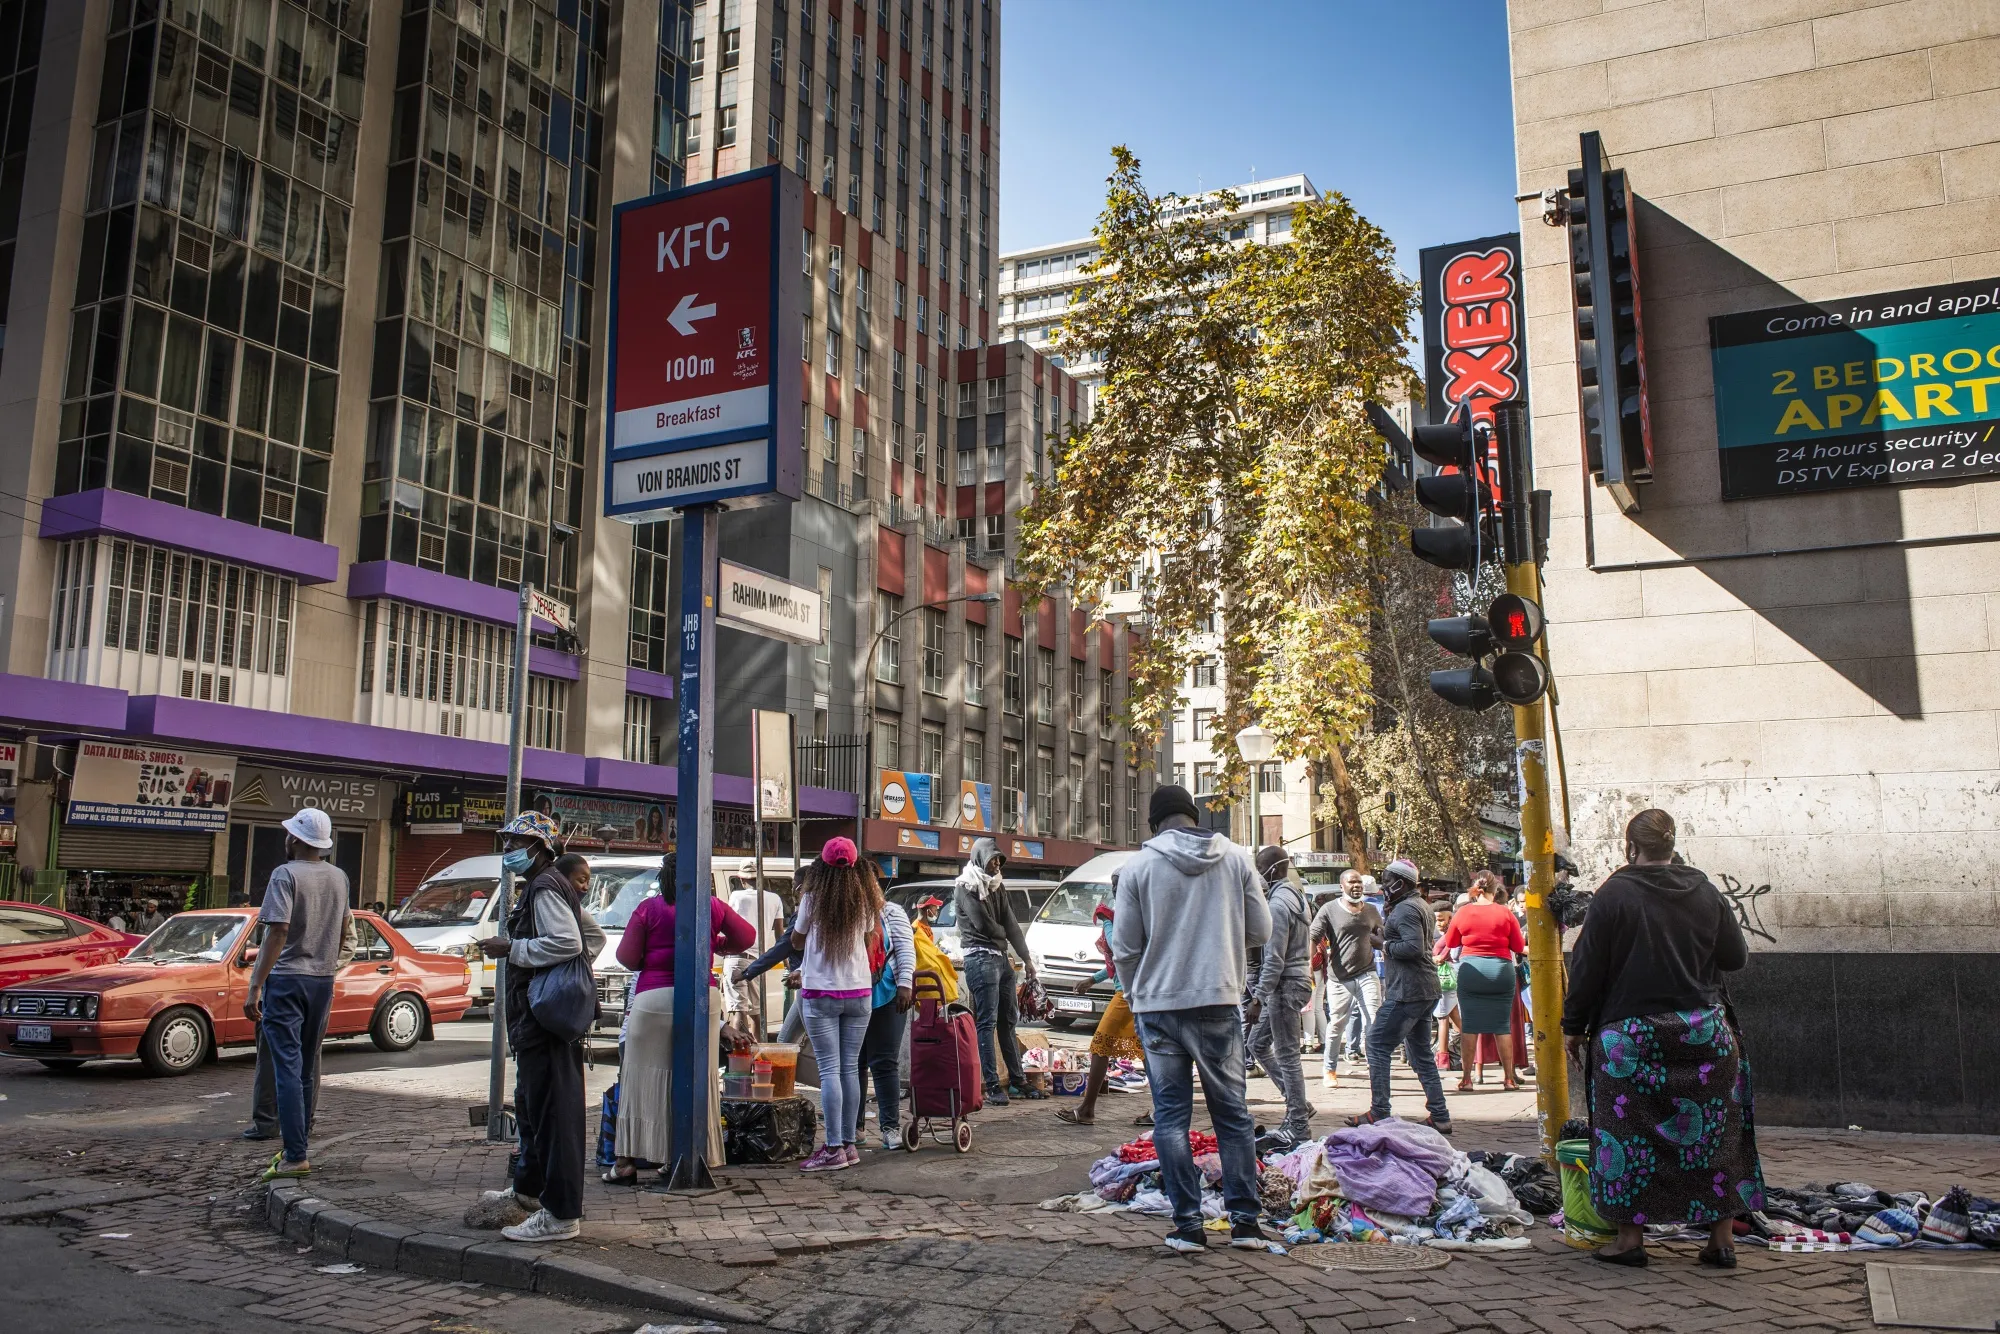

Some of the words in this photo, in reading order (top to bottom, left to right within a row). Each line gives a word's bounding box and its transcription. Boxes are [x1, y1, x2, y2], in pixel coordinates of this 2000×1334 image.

[657, 216, 730, 273] KFC
[1766, 313, 1843, 334] Come
[1850, 307, 1873, 324] in
[1880, 296, 1933, 320] and
[1938, 287, 2000, 315] appl
[736, 348, 758, 360] KFC
[666, 355, 715, 382] 100m
[1771, 370, 1798, 395] 2
[656, 404, 722, 429] Breakfast
[1773, 376, 2000, 435] APART
[1775, 446, 1806, 463] 24
[1812, 440, 1878, 460] hours
[1883, 430, 1978, 452] security
[637, 471, 663, 494] VON
[667, 461, 721, 488] BRANDIS
[725, 458, 741, 480] ST
[1777, 464, 1842, 485] DSTV
[1847, 459, 1934, 480] Explora
[1941, 453, 1956, 468] 2
[534, 595, 557, 621] JEPPE
[560, 606, 566, 618] ST
[732, 581, 767, 611] RAHIMA
[769, 593, 799, 621] MOOSA
[800, 604, 811, 624] ST
[683, 613, 699, 632] JHB
[685, 633, 696, 651] 13
[84, 744, 106, 757] DATA
[107, 746, 121, 758] ALI
[149, 751, 176, 764] SHOES
[177, 756, 184, 765] &
[280, 775, 375, 796] WIMPIES
[415, 792, 440, 802] FLATS
[75, 804, 96, 813] MALIK
[289, 794, 366, 813] TOWER
[414, 804, 433, 819] TO
[436, 803, 460, 819] LET
[71, 812, 89, 821] SHOP
[106, 815, 120, 823] CNR
[119, 816, 137, 824] JEPPE
[142, 817, 156, 825] VON
